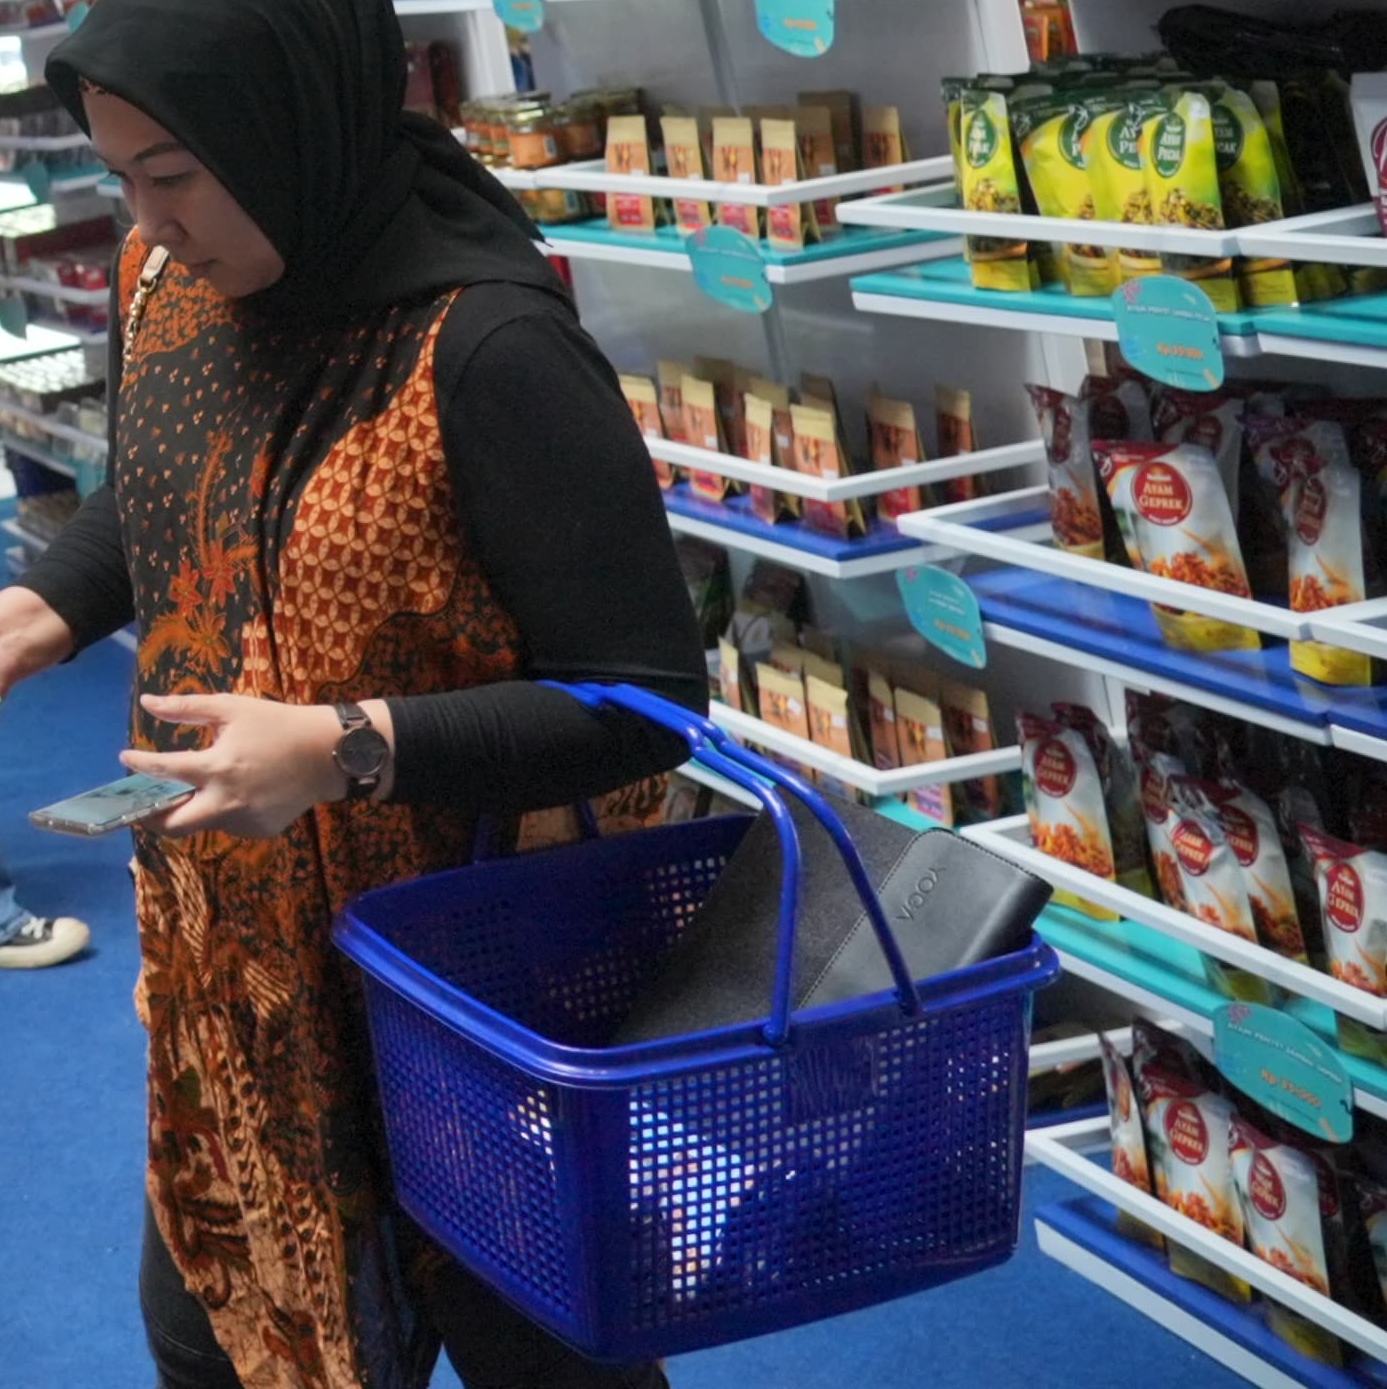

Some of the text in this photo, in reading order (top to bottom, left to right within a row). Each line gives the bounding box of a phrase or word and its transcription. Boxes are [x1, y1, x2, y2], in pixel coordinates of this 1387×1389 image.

[1143, 482, 1174, 496] AYAM
[1139, 495, 1184, 510] GEPREK
[896, 866, 947, 921] YOGA
